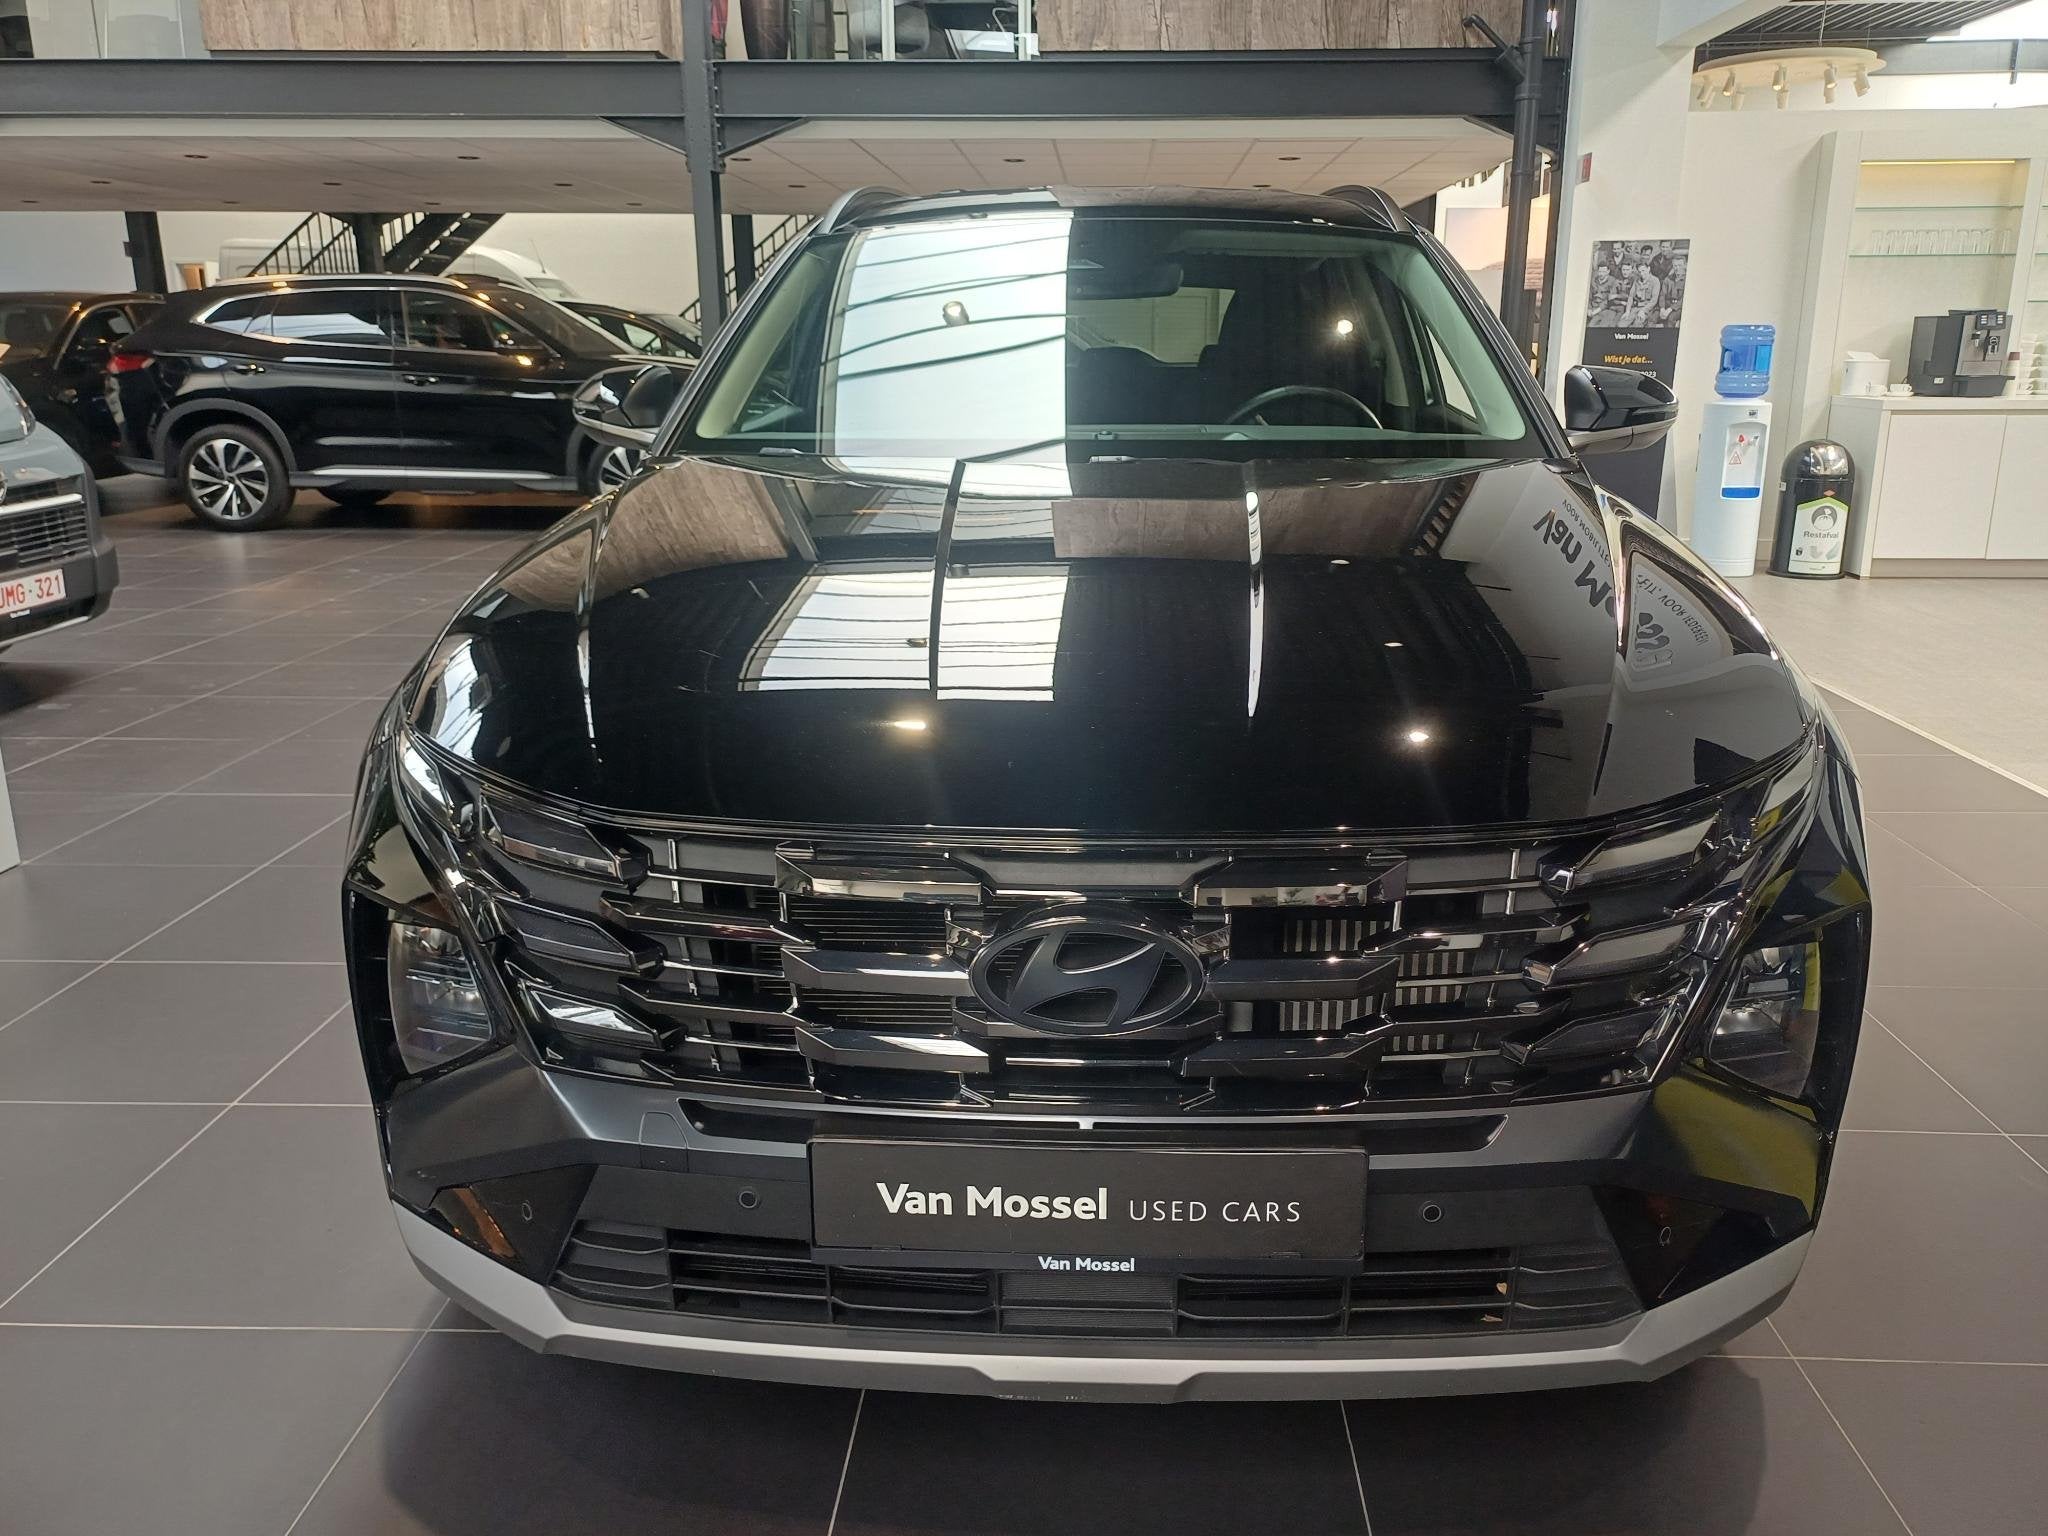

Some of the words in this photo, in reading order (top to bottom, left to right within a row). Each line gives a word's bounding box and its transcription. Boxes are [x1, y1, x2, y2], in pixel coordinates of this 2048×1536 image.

[1604, 355, 1622, 363] Wist
[1803, 530, 1839, 539] Restafval
[876, 1183, 952, 1215] Van
[967, 1185, 1108, 1220] Mossel
[1129, 1200, 1207, 1221] USED
[1222, 1201, 1300, 1222] CARS
[1038, 1256, 1070, 1270] Van
[1075, 1257, 1135, 1272] Mossel
